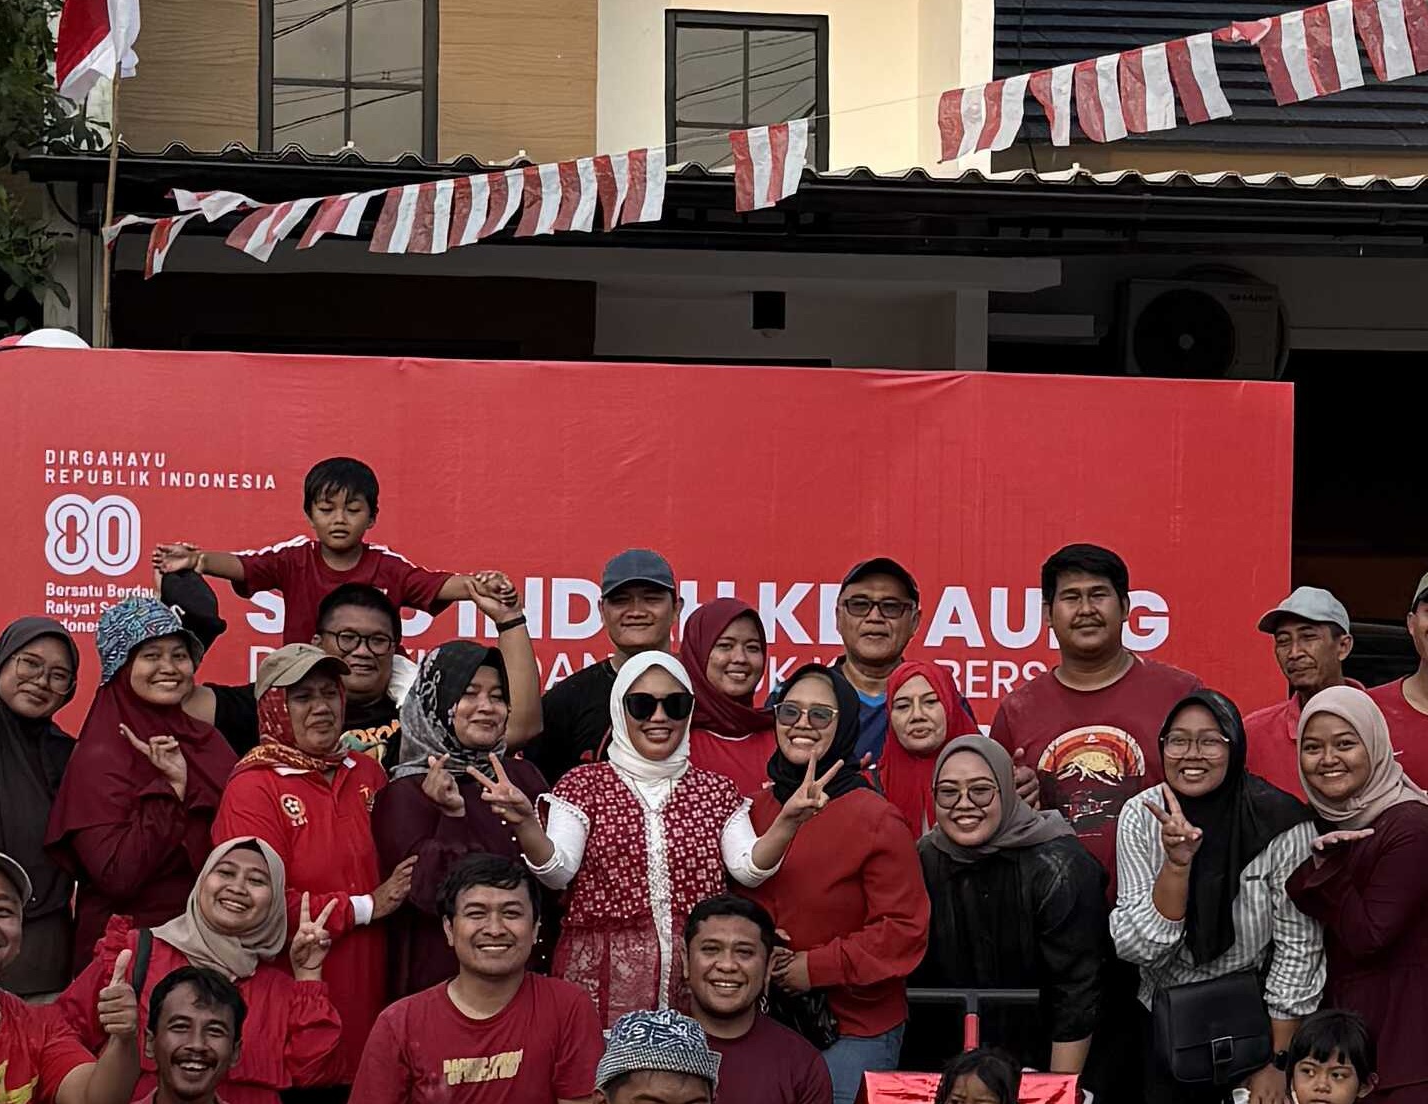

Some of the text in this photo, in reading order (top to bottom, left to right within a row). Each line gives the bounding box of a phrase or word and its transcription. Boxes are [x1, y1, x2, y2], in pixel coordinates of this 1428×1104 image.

[45, 449, 166, 468] DIRGAHAYU
[45, 469, 277, 490] REPUBLIK INDONESIA
[45, 493, 141, 577] 80
[45, 582, 103, 597] Bersatu
[45, 600, 96, 617] Rakyat
